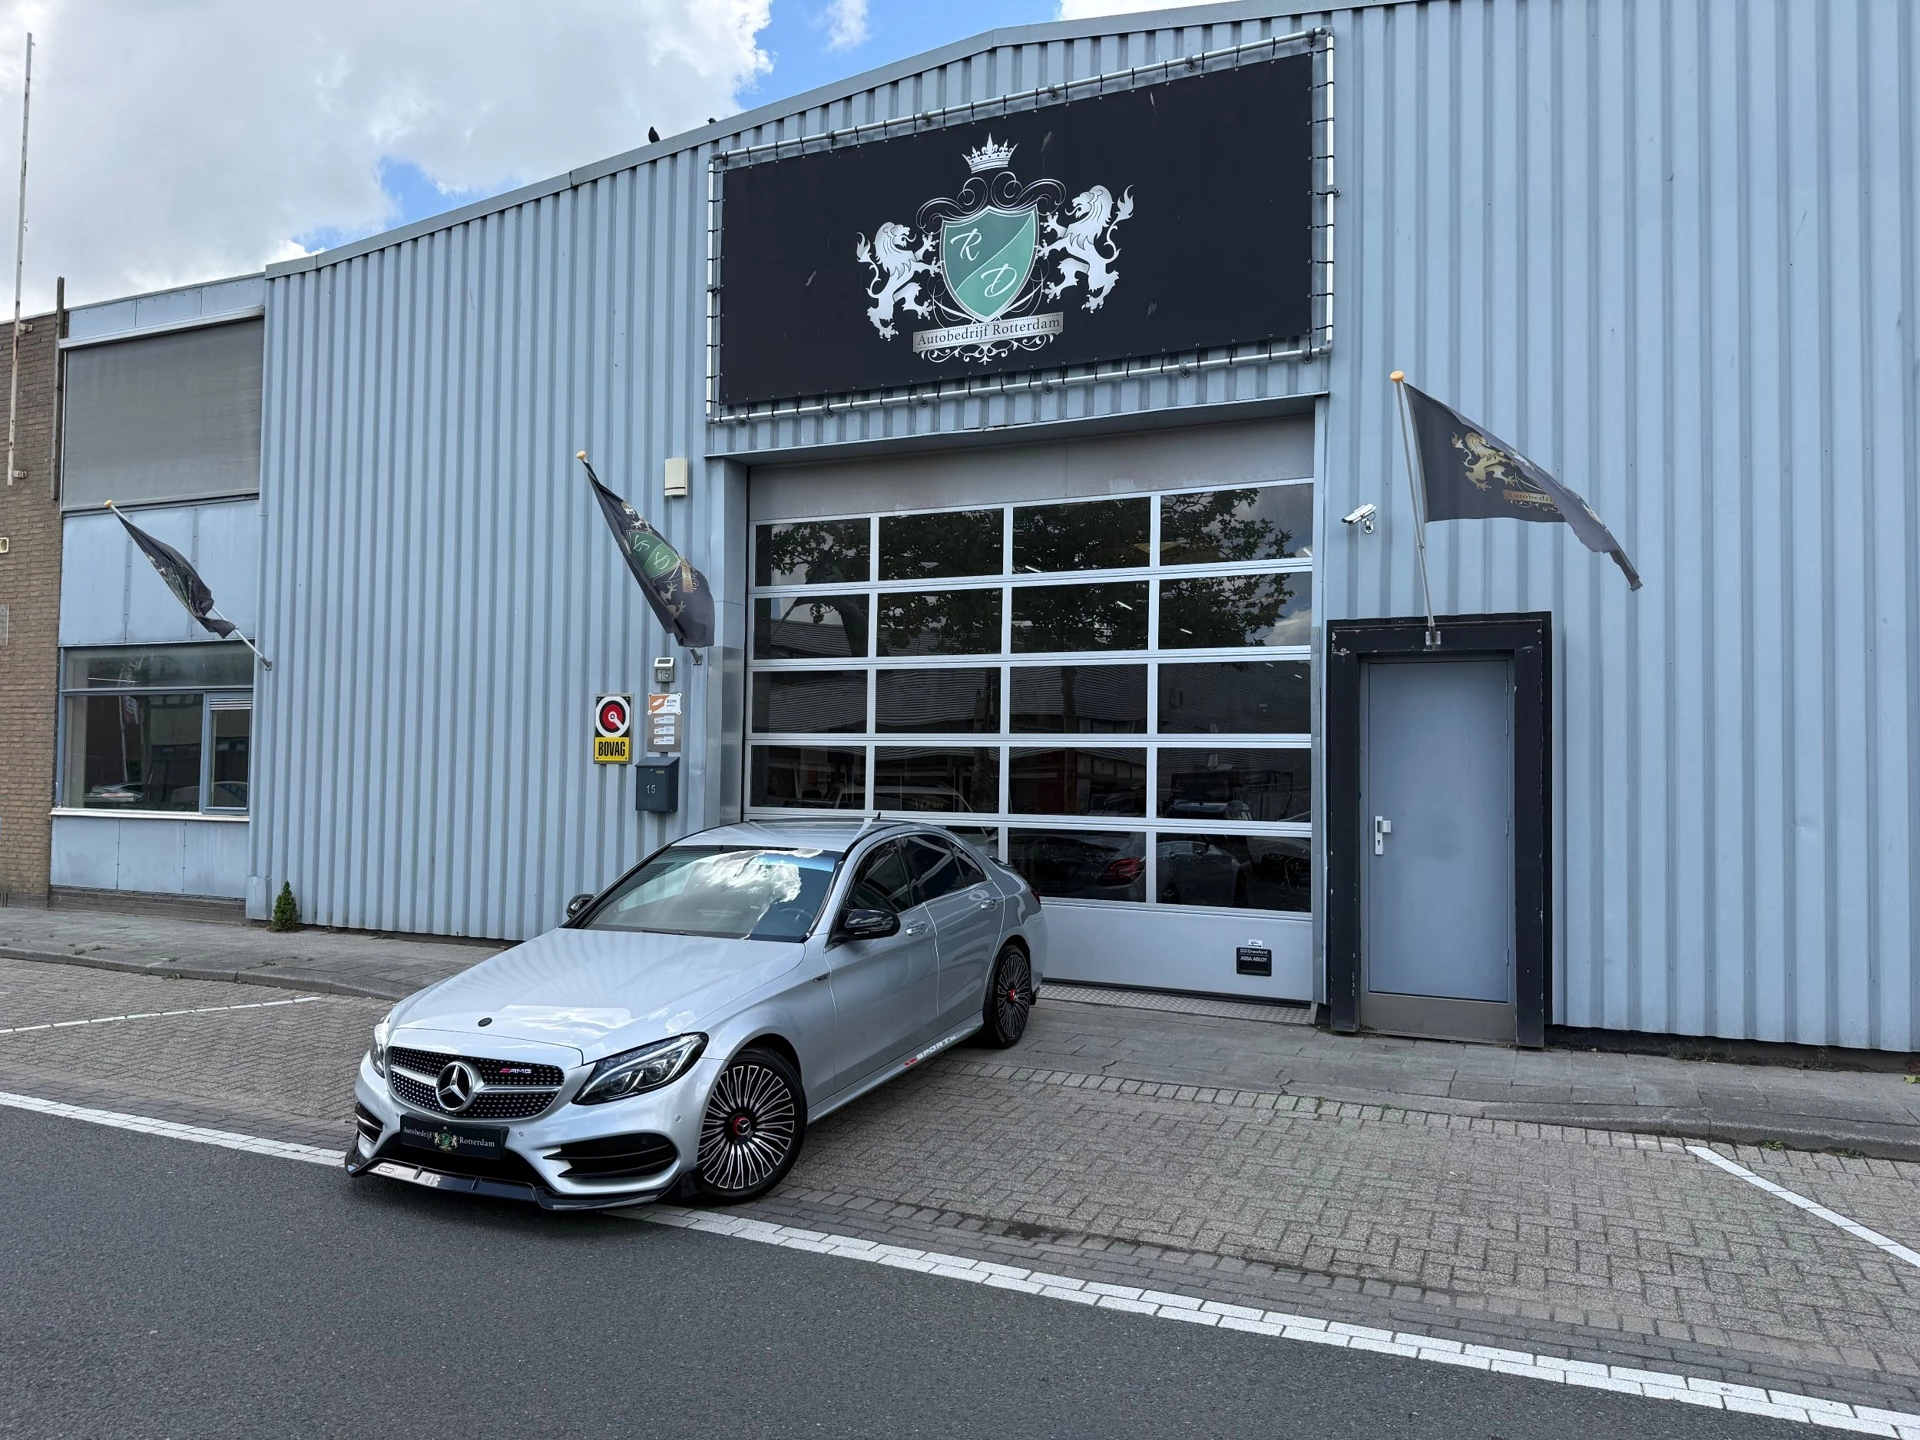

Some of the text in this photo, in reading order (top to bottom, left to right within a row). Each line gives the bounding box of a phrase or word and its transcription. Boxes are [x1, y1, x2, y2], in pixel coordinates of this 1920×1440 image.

[949, 227, 982, 261] R
[980, 263, 1018, 298] D
[917, 317, 1060, 346] Autobedrijf Rotterdam
[598, 741, 626, 757] BOVAG
[646, 784, 656, 794] 15
[402, 1126, 495, 1148] Autobedrijf Rotterdam
